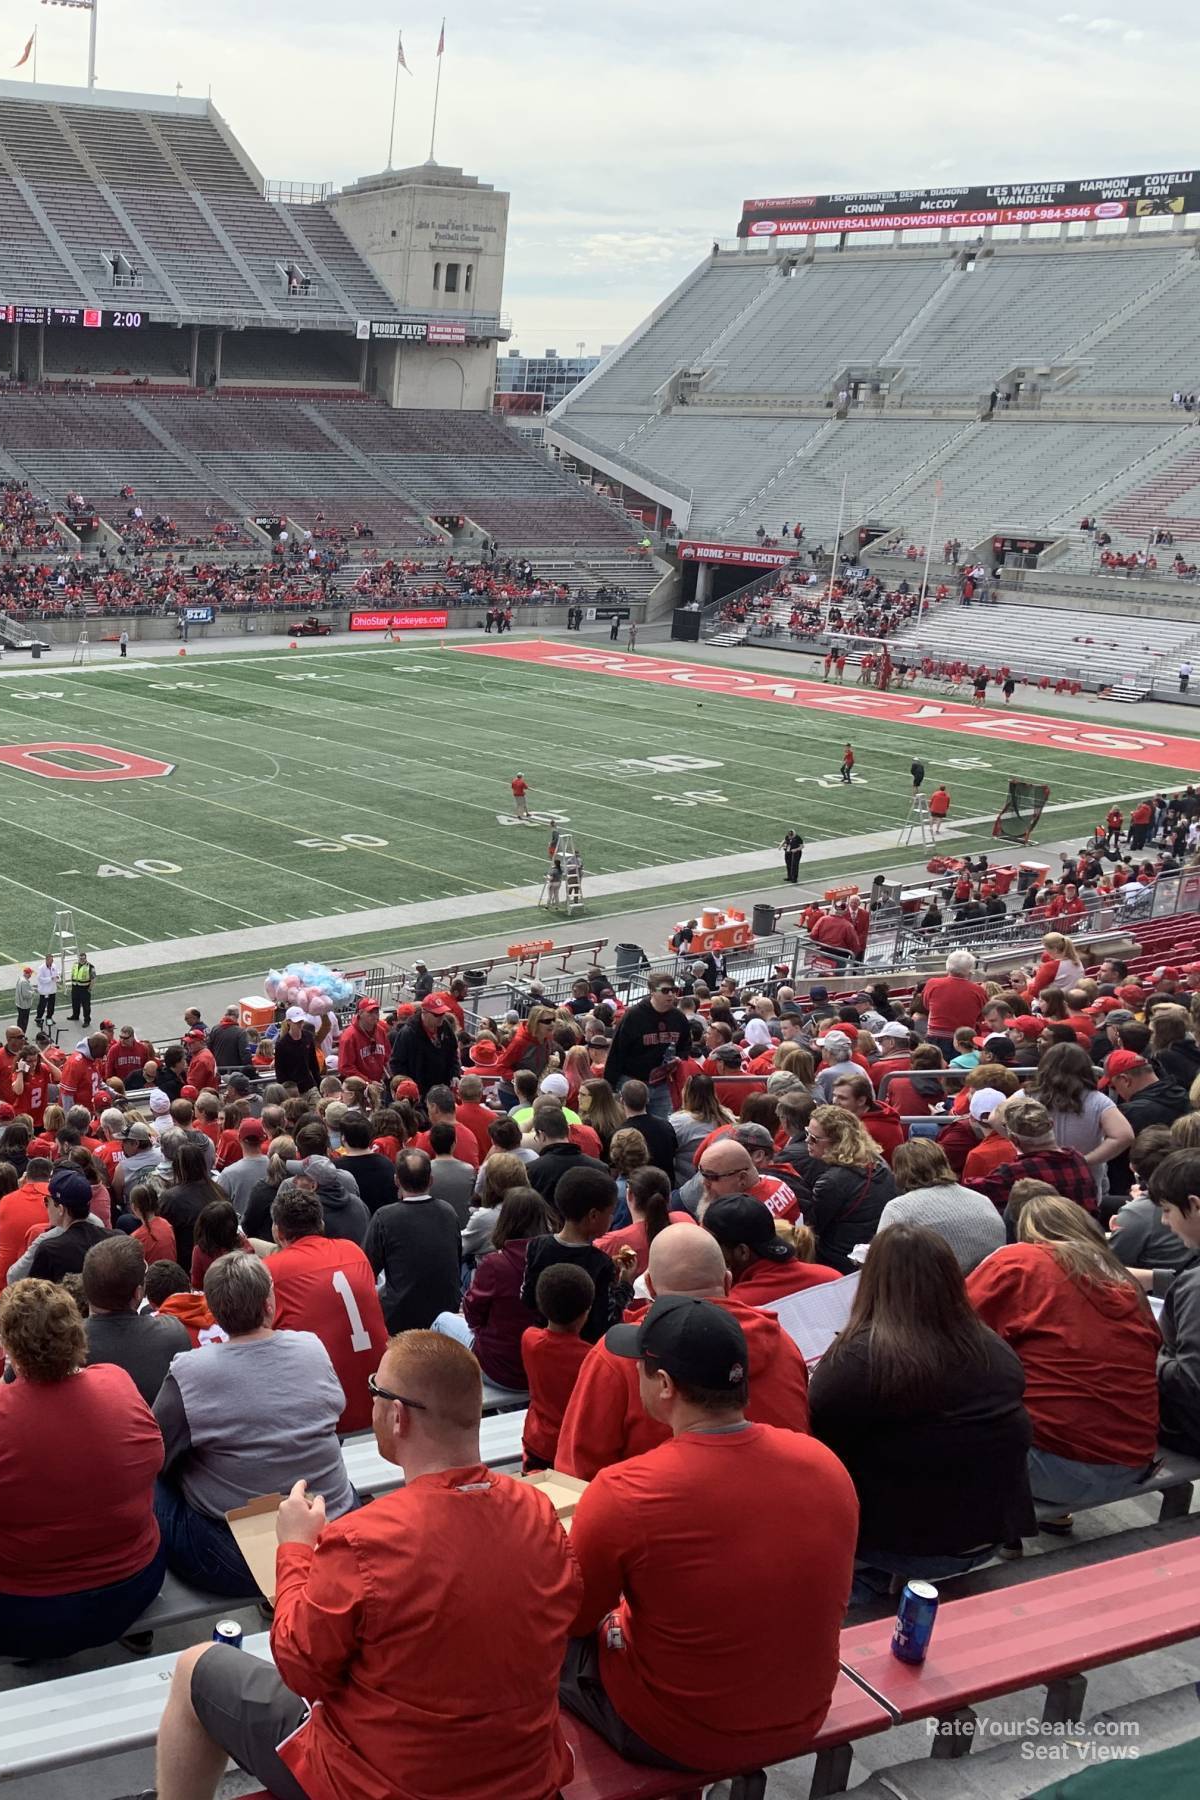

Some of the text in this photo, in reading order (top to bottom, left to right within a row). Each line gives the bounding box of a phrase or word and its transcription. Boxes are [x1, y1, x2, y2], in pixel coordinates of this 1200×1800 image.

[1079, 179, 1129, 192] HARMON
[1144, 173, 1193, 186] COVELLI
[931, 188, 969, 196] DIAMOND
[987, 184, 1065, 197] LES WEXNER
[1102, 186, 1169, 199] WOLFE FDN
[792, 198, 814, 207] Society
[920, 200, 958, 210] McCOY
[997, 194, 1054, 205] WANDELL
[845, 204, 884, 214] CRONIN
[779, 212, 997, 232] WWW.UNIVERSALWINDOWSDIRECT.COM
[1006, 207, 1091, 220] 1-800-984-5846
[113, 313, 141, 327] 2:00
[372, 323, 400, 333] WOODY
[402, 325, 427, 335] HAYES
[696, 548, 724, 559] HOME
[186, 609, 207, 619] BTN
[542, 653, 1168, 751] BUCKEYES
[652, 789, 729, 807] 30
[293, 833, 389, 853] 50
[97, 858, 183, 879] 40
[704, 934, 715, 949] G
[733, 930, 743, 944] G
[242, 1010, 252, 1026] G
[31, 1087, 41, 1108] 2
[332, 1270, 373, 1353] 1
